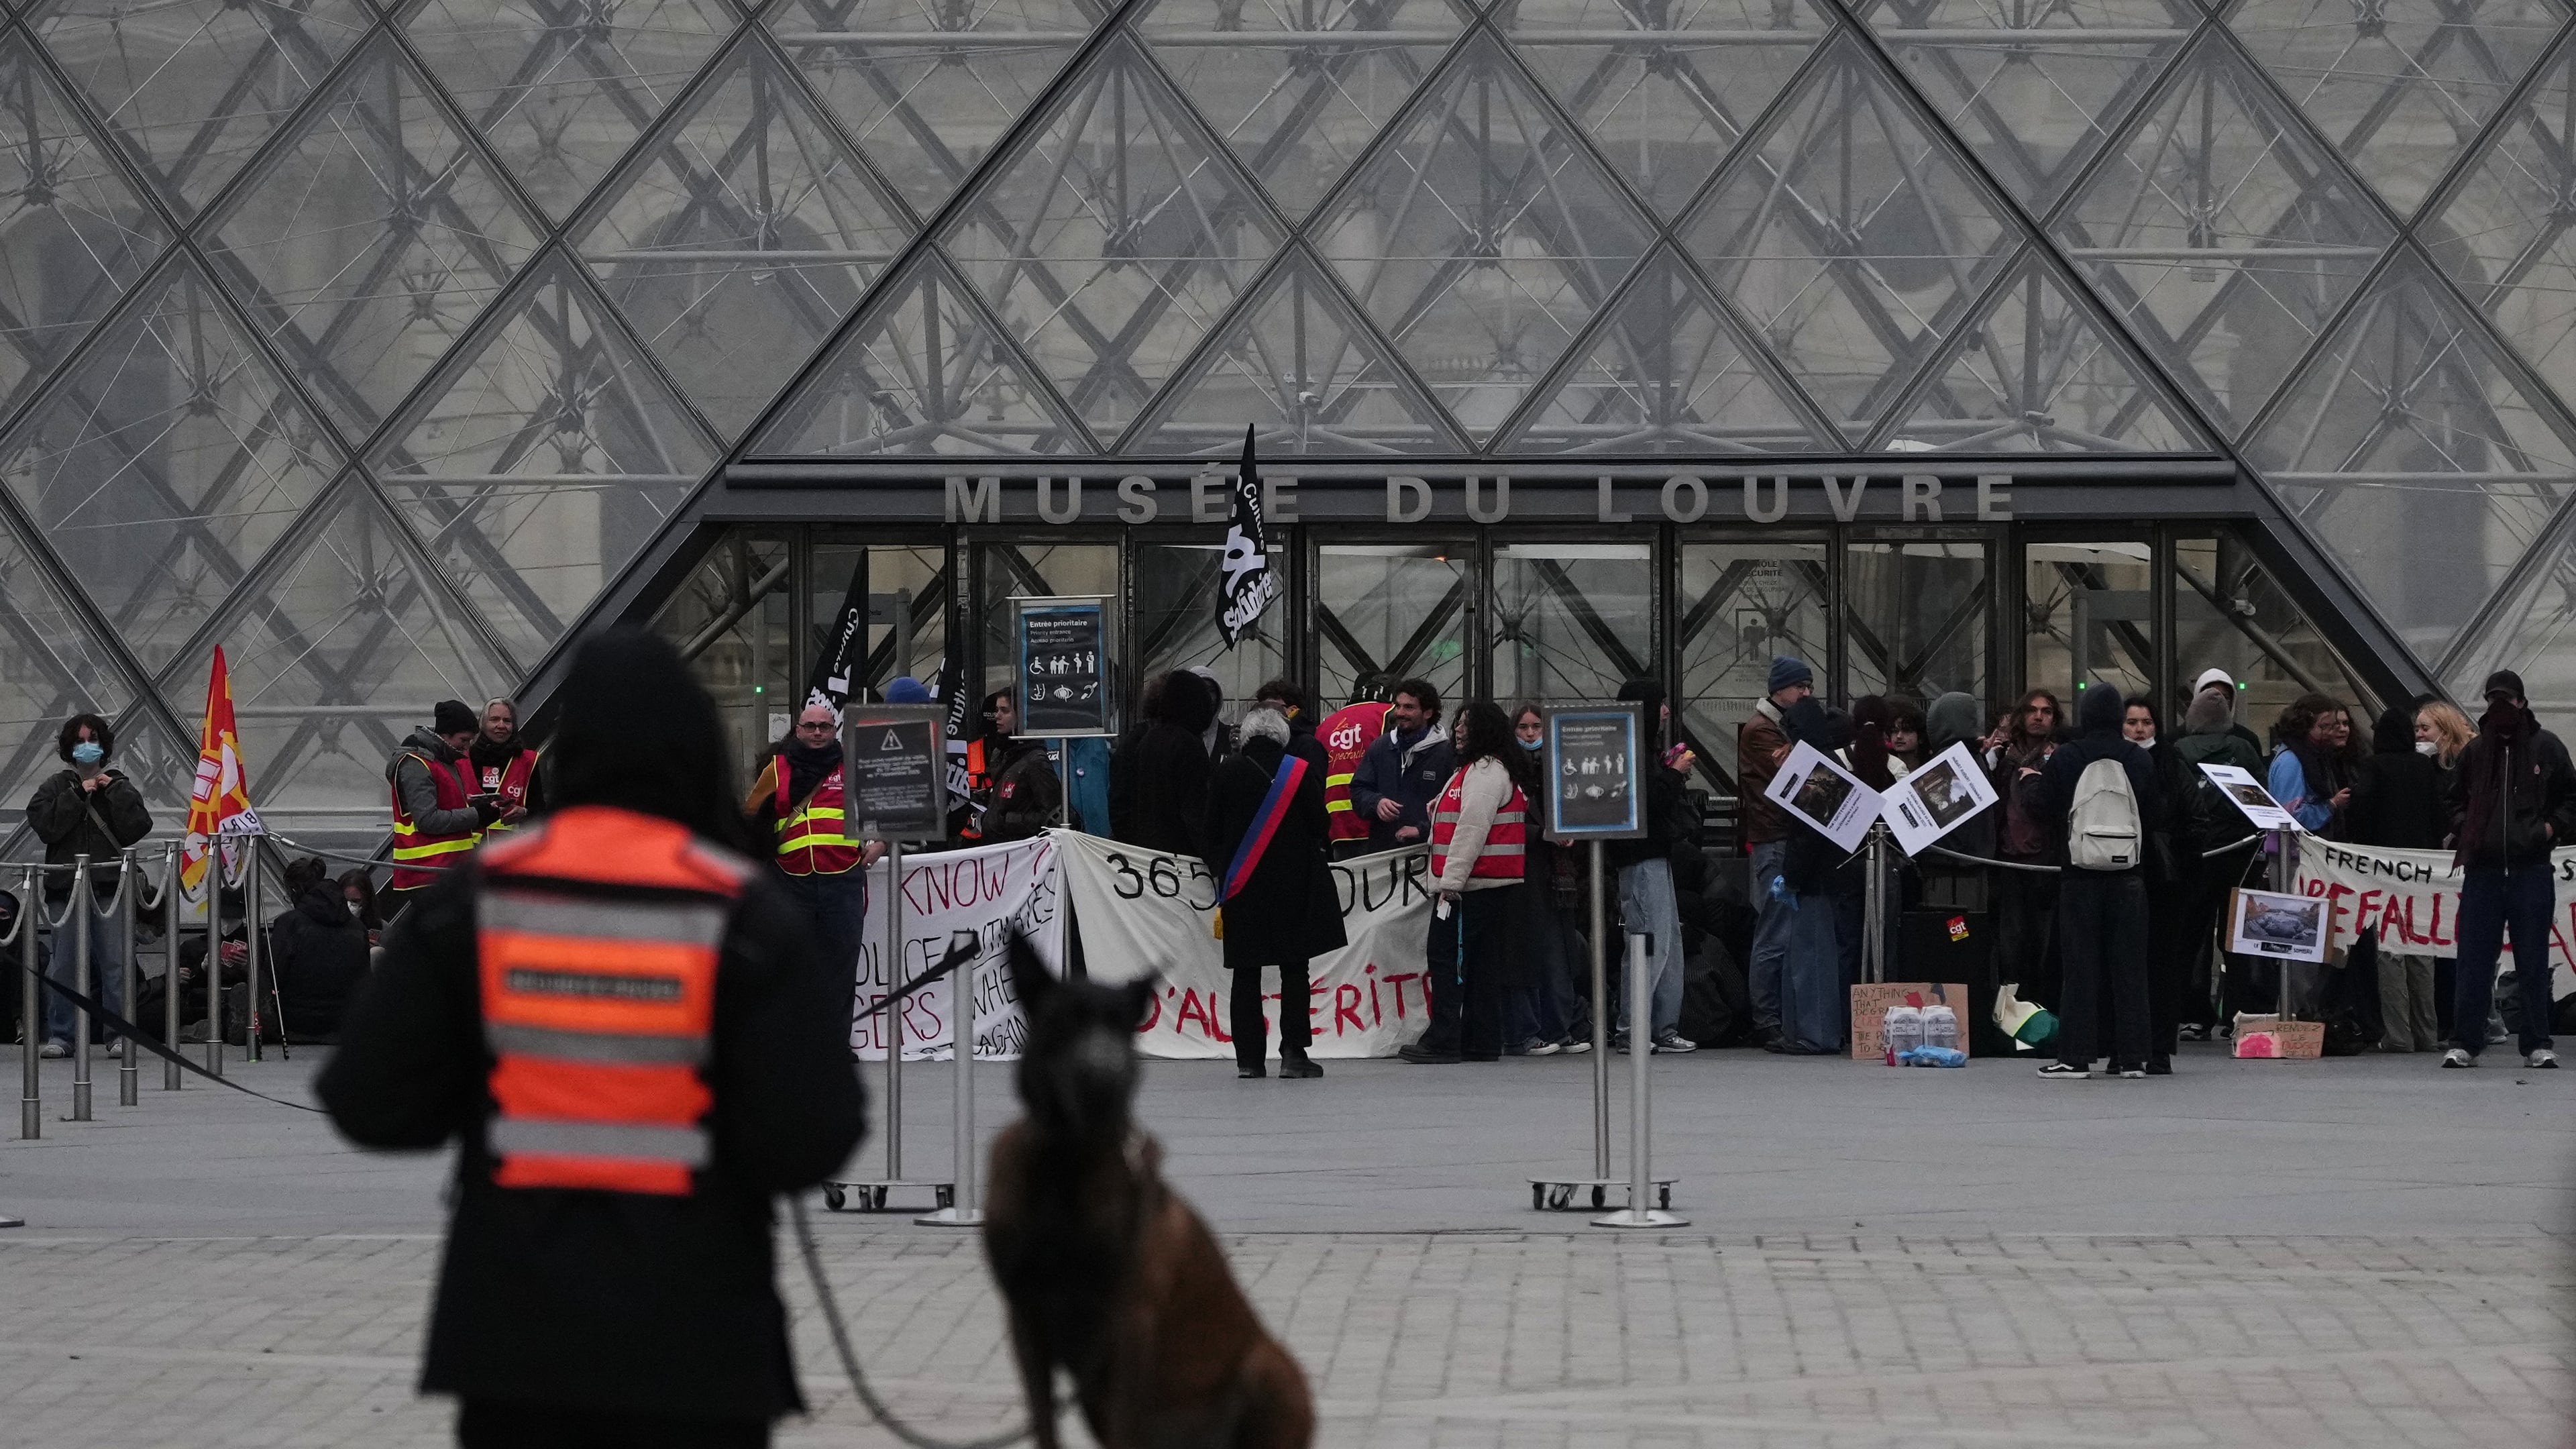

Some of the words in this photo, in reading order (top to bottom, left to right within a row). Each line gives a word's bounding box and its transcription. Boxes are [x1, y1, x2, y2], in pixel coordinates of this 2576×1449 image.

[945, 462, 1300, 524] MUSÉE
[1387, 475, 1509, 524] DU
[1598, 475, 2014, 524] LOUVRE
[1243, 482, 1265, 551] Culture
[1053, 619, 1088, 629] prioritaire
[1224, 570, 1273, 643] Solidaire
[1330, 723, 1362, 749] cgt
[484, 775, 500, 784] cgt
[1107, 853, 1218, 910] 365
[2326, 847, 2433, 883] FRENCH
[901, 853, 1009, 916] KNOW
[1949, 921, 1967, 934] cgt
[2275, 1023, 2321, 1033] RENDEZ
